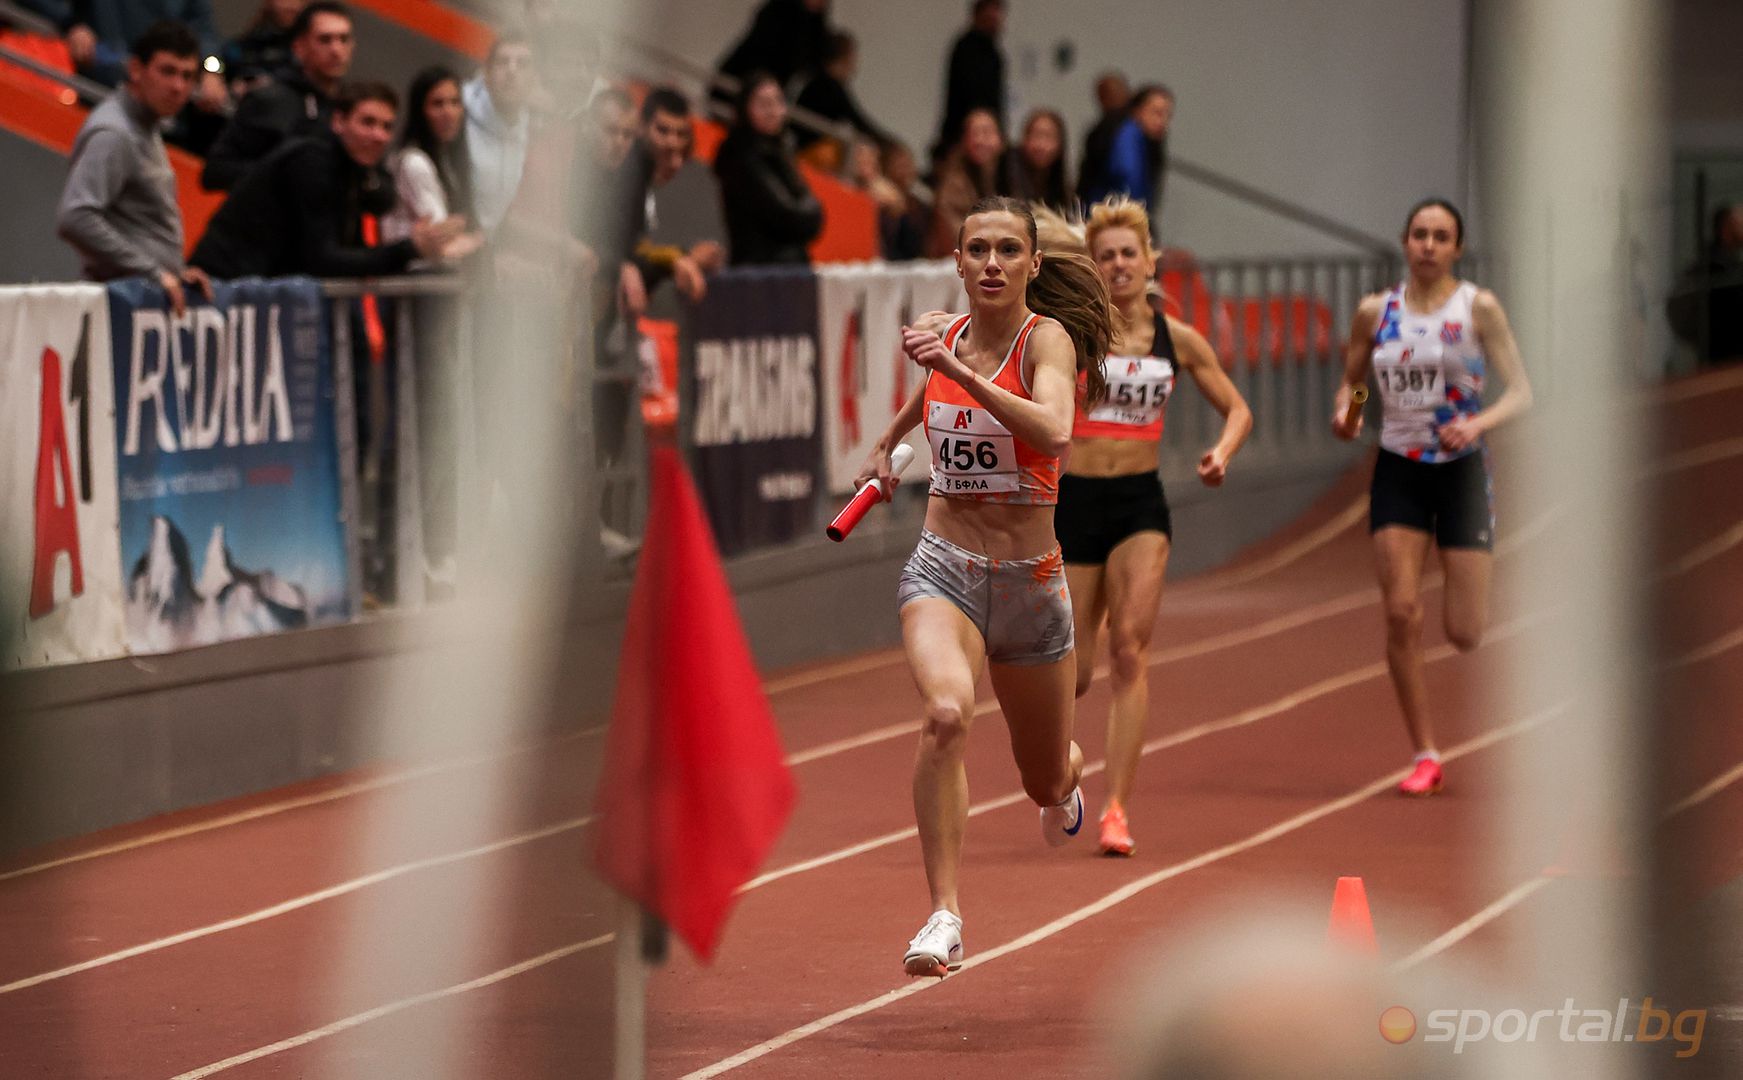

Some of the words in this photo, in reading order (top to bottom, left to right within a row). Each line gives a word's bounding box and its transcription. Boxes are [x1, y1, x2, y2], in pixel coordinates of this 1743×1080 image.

[1381, 368, 1438, 392] 1387
[1104, 383, 1167, 408] 1515
[953, 409, 972, 429] A1
[939, 437, 998, 471] 456
[30, 313, 92, 620] A1
[955, 479, 989, 490] БФЛА
